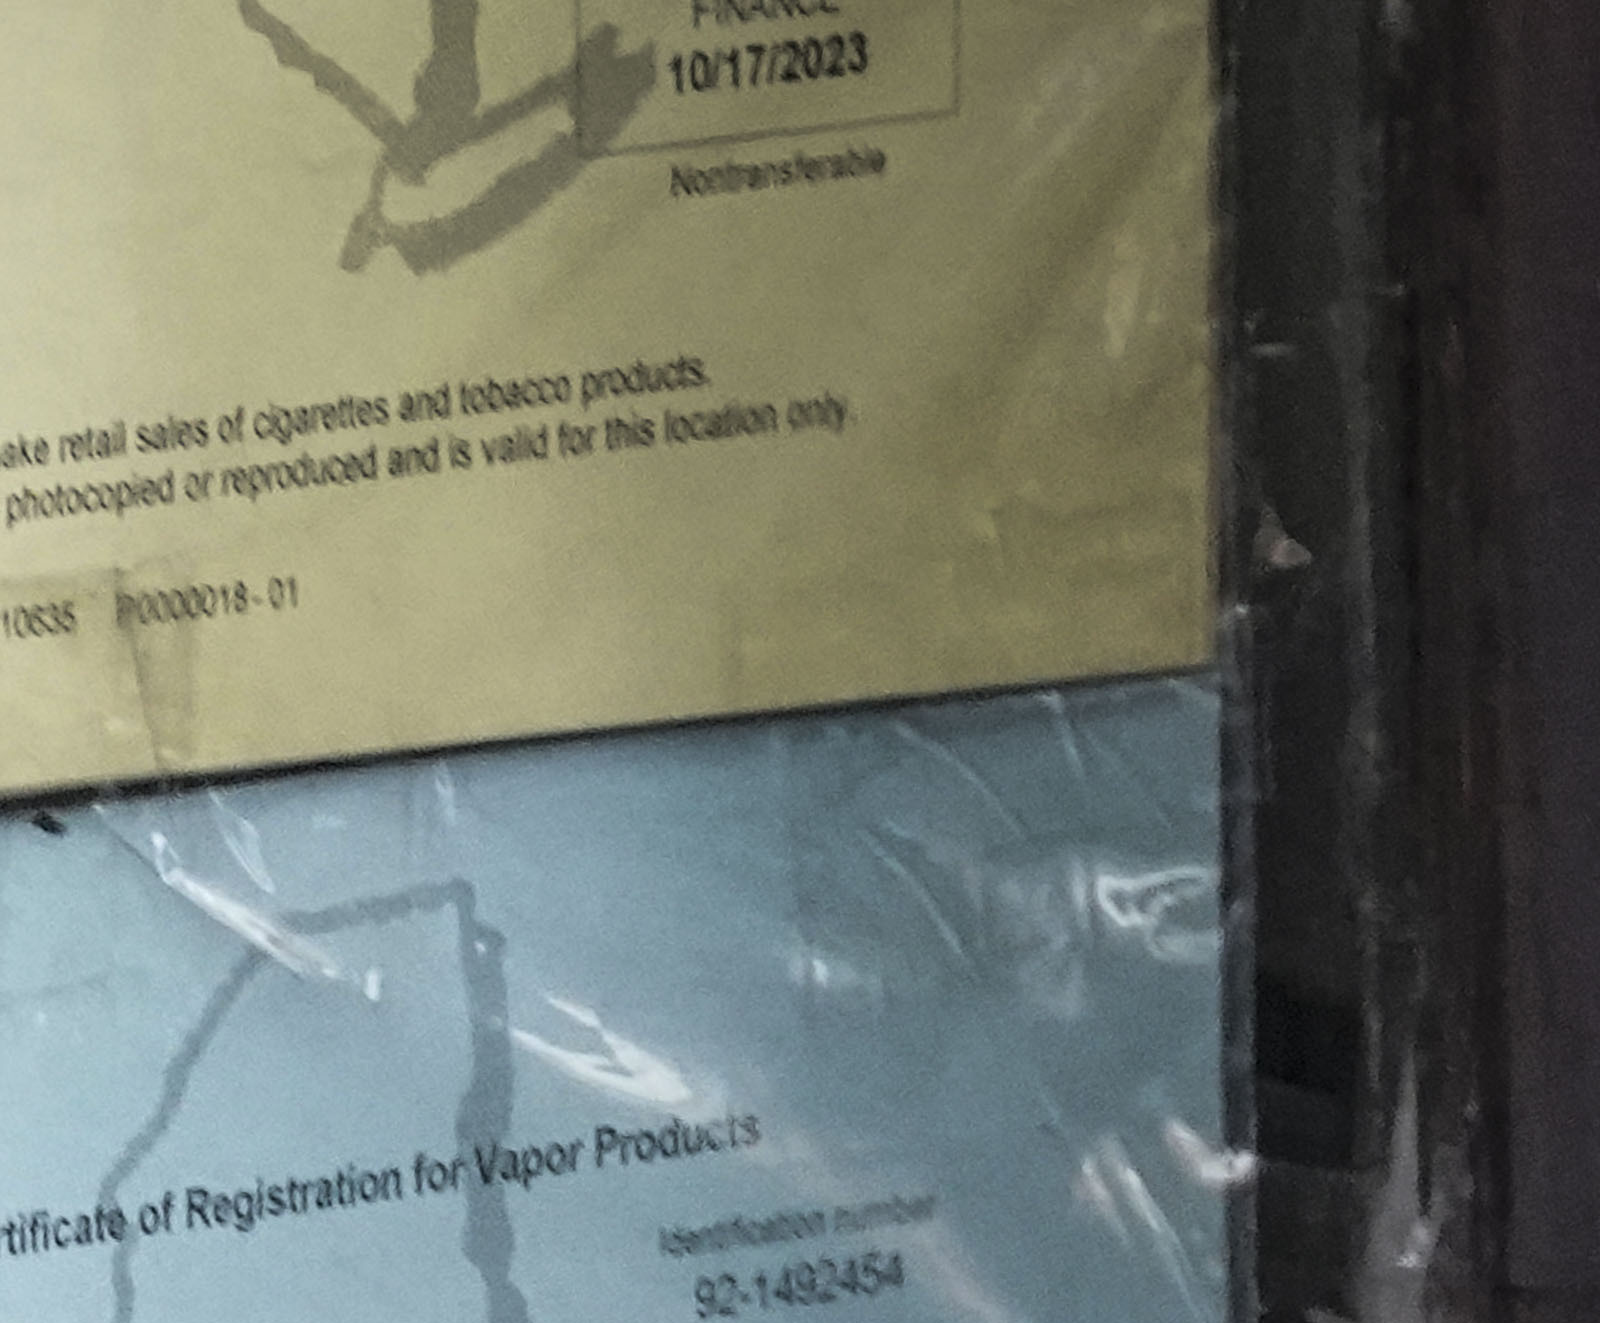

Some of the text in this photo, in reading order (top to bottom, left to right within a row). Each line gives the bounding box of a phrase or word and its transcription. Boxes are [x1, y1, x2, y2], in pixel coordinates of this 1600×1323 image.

[668, 30, 868, 94] 10/17/2023
[7, 469, 175, 524] photocopied
[185, 472, 215, 498] or
[222, 446, 376, 495] reproduced
[389, 438, 439, 474] and
[450, 435, 471, 467] is
[482, 425, 548, 463] valid
[558, 423, 595, 454] for
[606, 414, 655, 449] this
[665, 402, 777, 442] location
[59, 421, 125, 460] retail
[137, 414, 208, 450] sales
[217, 406, 245, 441] of
[254, 392, 390, 438] cigarettes
[401, 382, 451, 419] and
[461, 375, 571, 412] tobacco
[139, 1195, 177, 1238] of
[188, 1163, 402, 1234] Registration
[413, 1150, 468, 1195] for
[473, 1141, 585, 1193] Vapor
[595, 1111, 761, 1166] Products
